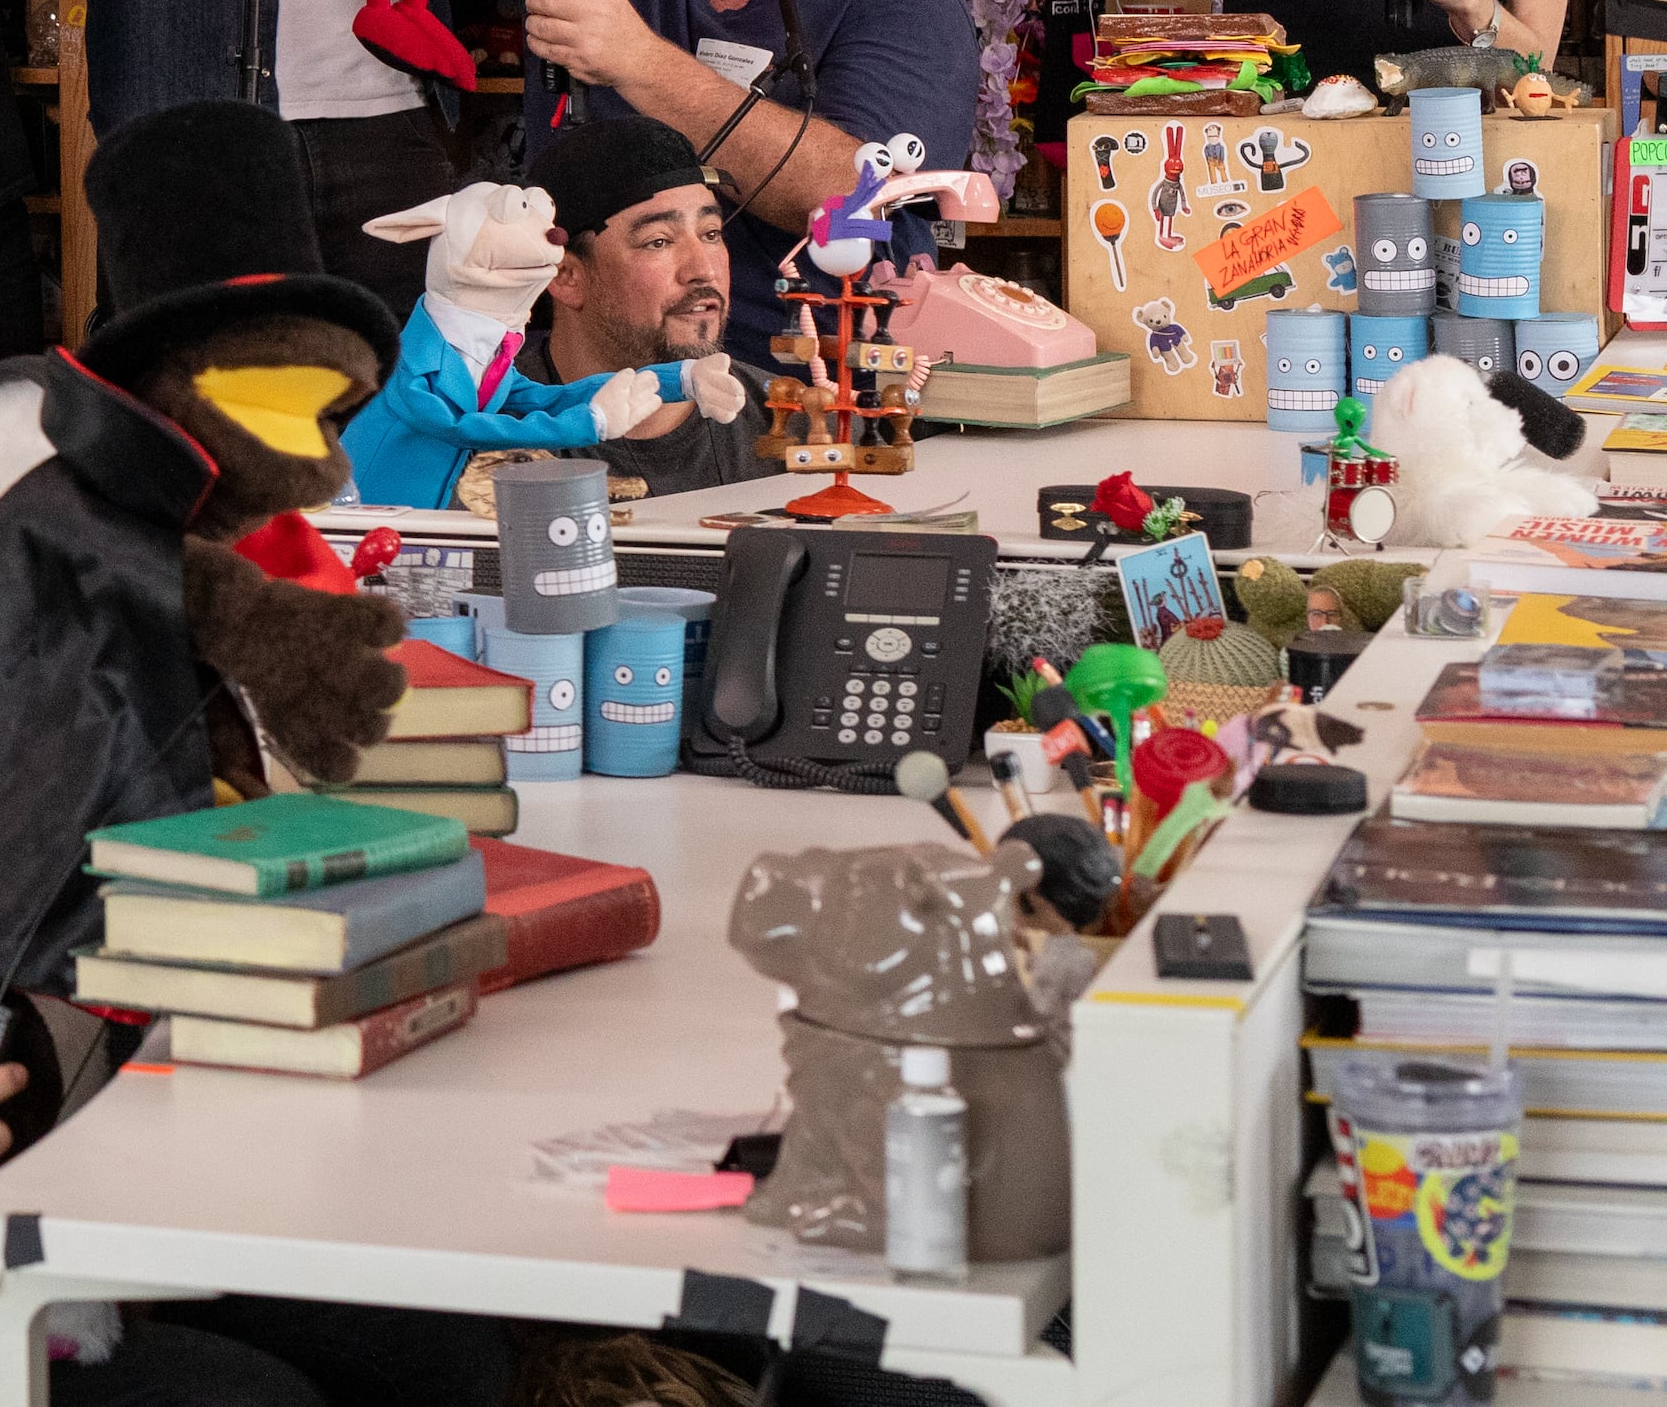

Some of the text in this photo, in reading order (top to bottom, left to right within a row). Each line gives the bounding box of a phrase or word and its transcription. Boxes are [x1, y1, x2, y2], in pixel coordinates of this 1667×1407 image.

[1196, 183, 1232, 195] MUSEO
[1219, 237, 1240, 261] LA
[1239, 209, 1289, 248] GRAN
[1218, 241, 1289, 289] ZANAHORIA
